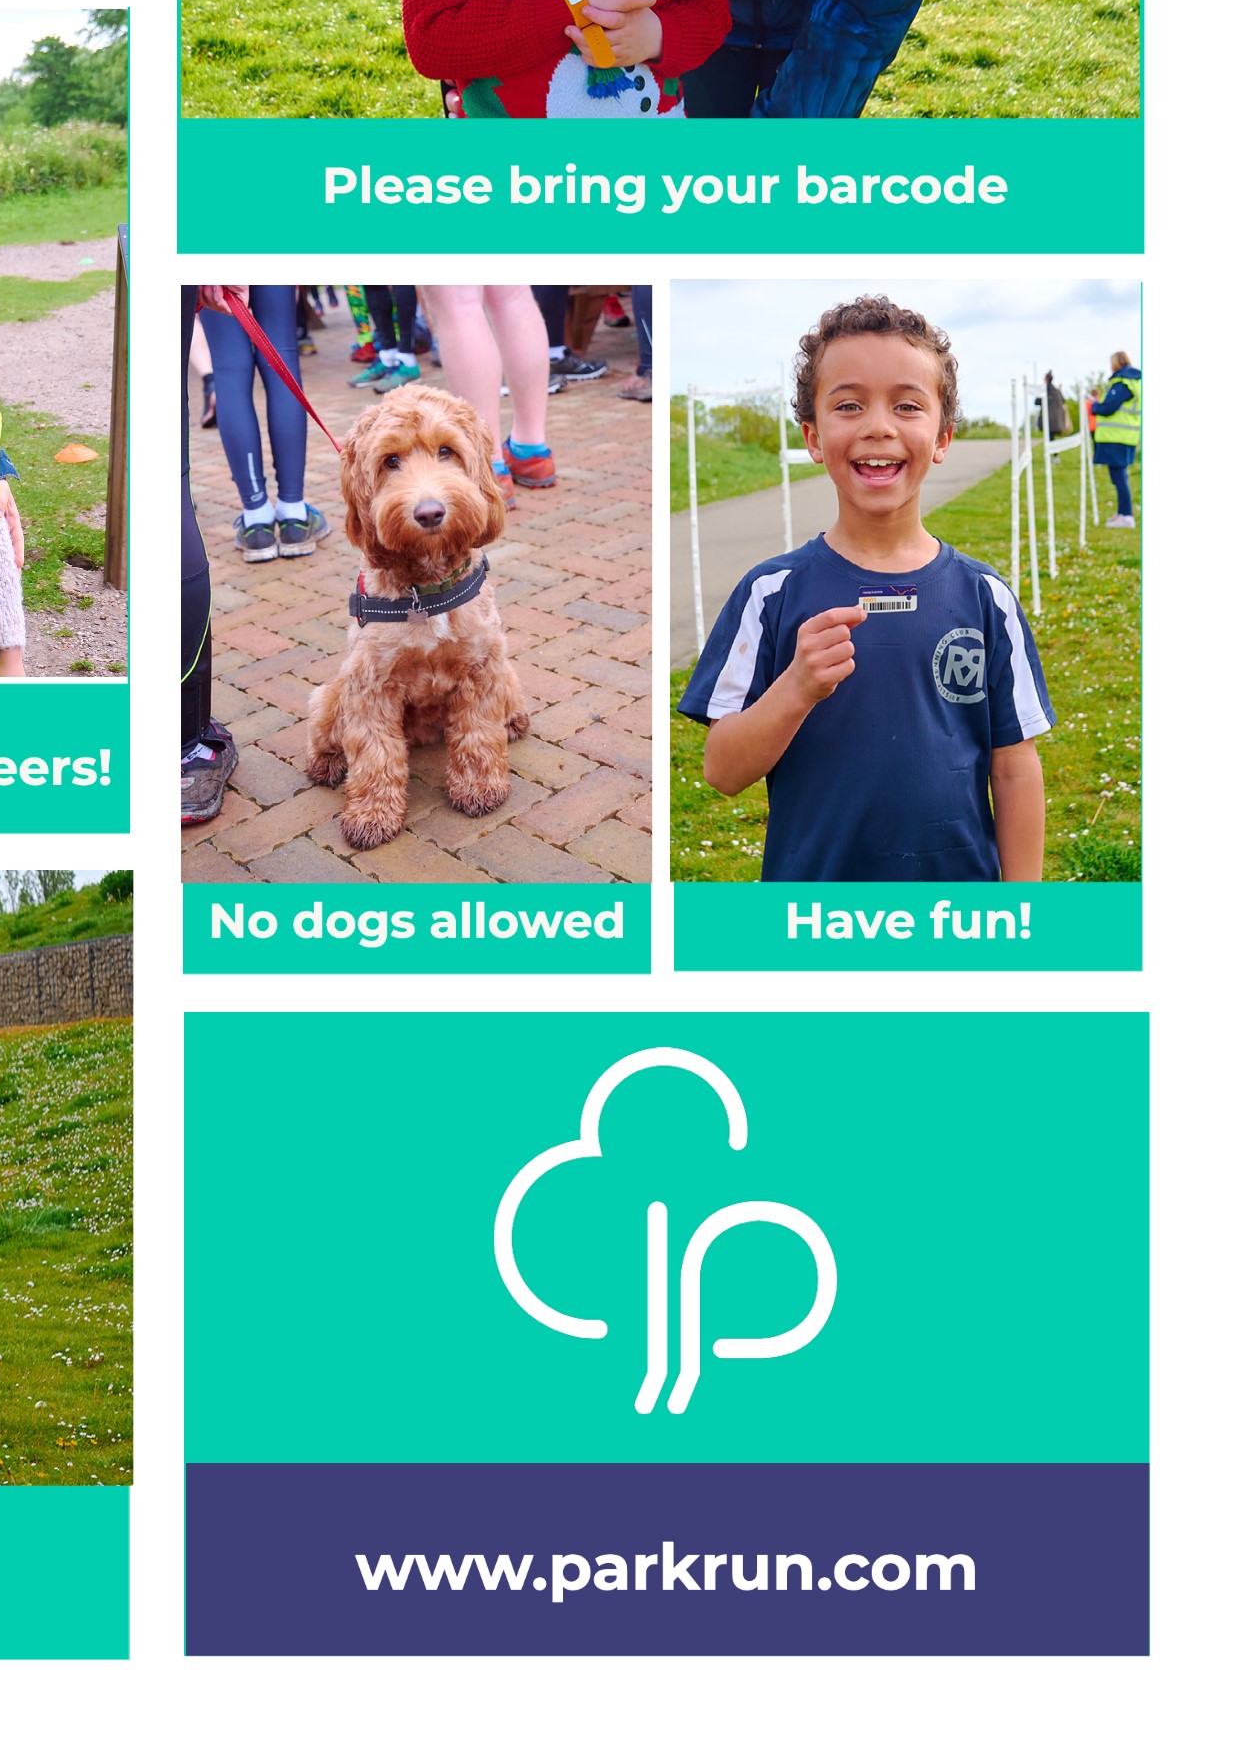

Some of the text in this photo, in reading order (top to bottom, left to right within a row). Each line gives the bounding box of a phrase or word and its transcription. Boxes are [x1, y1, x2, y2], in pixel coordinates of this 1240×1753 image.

[325, 163, 1008, 214] Please bring your barcode
[950, 629, 970, 639] CLUB
[211, 901, 623, 948] No dogs allowed
[788, 900, 1031, 939] Have fun!
[355, 1541, 975, 1603] www.parkrun.com
